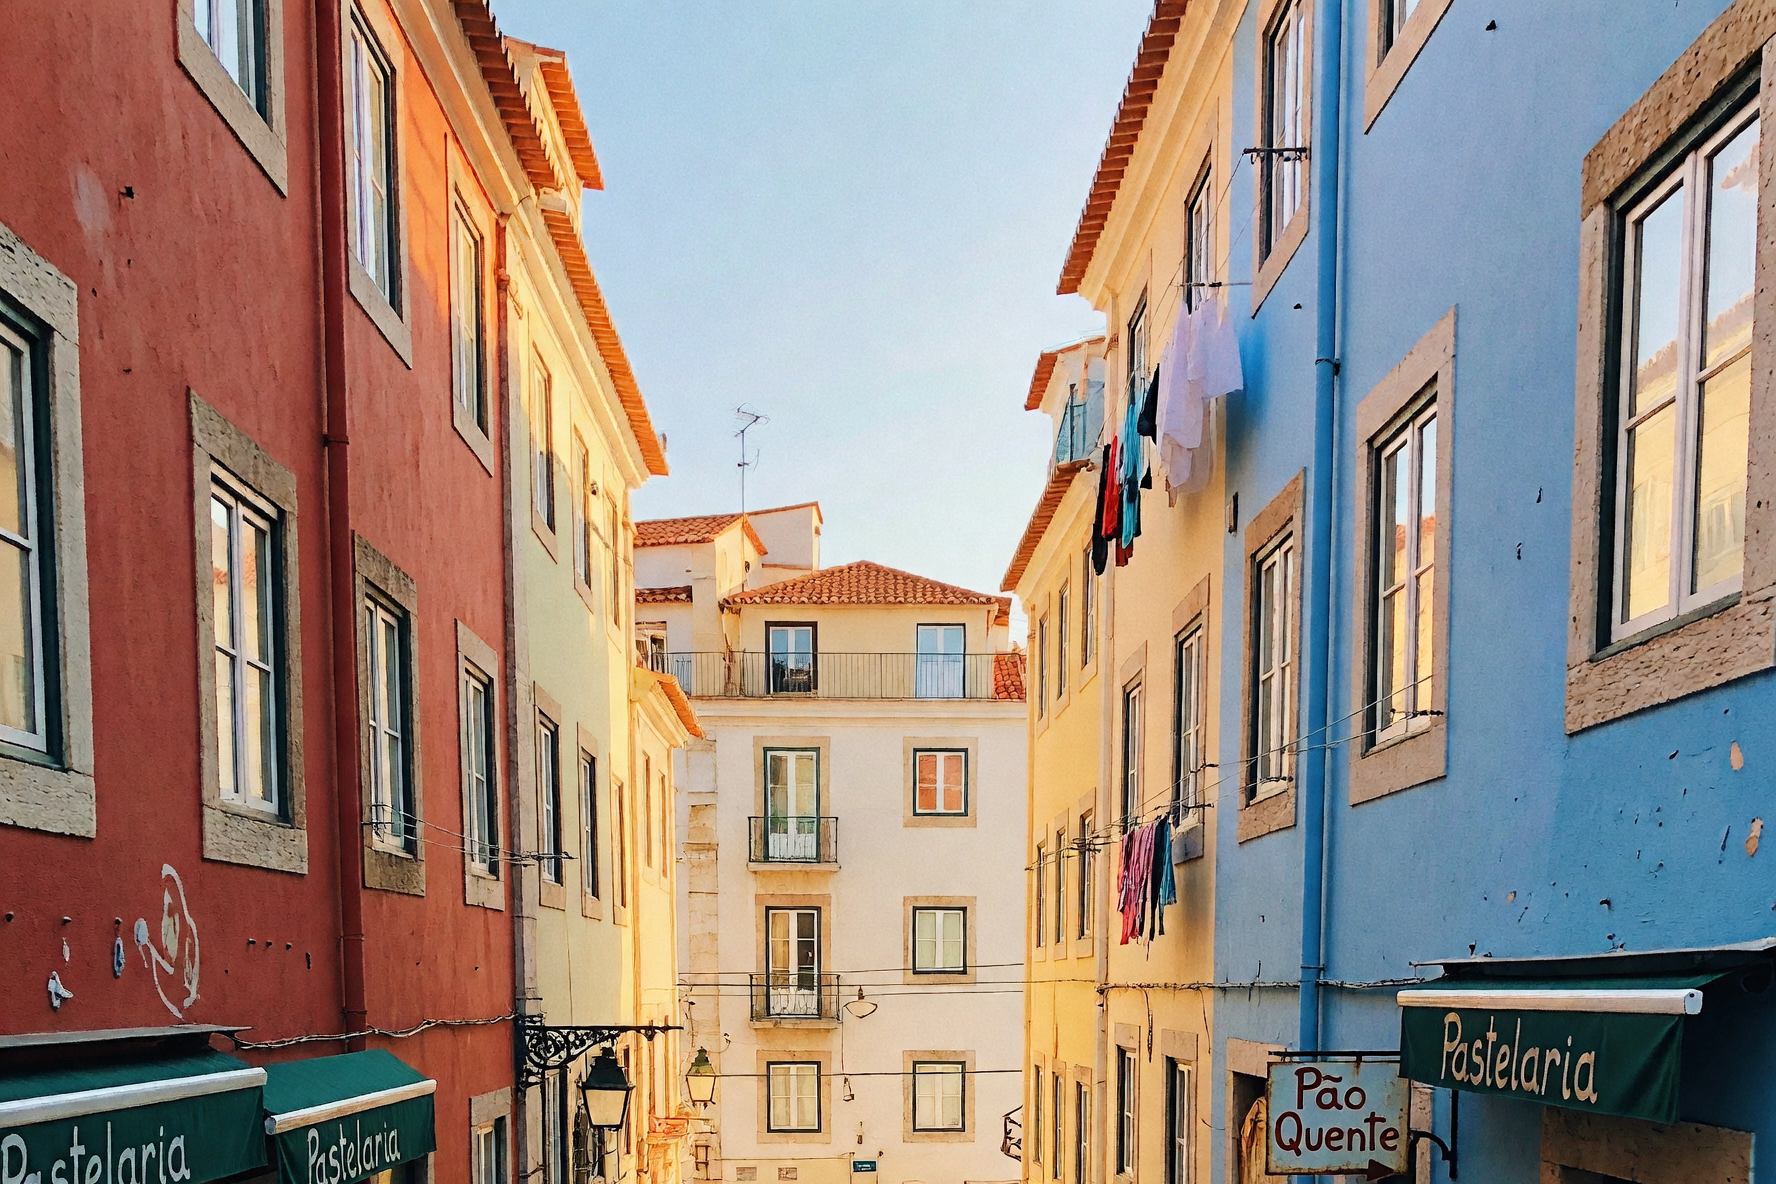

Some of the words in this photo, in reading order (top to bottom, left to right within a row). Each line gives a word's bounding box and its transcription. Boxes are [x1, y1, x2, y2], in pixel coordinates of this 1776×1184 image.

[1440, 1011, 1598, 1104] Pastelaria
[1294, 1066, 1367, 1110] Pão
[1274, 1111, 1400, 1157] Quente
